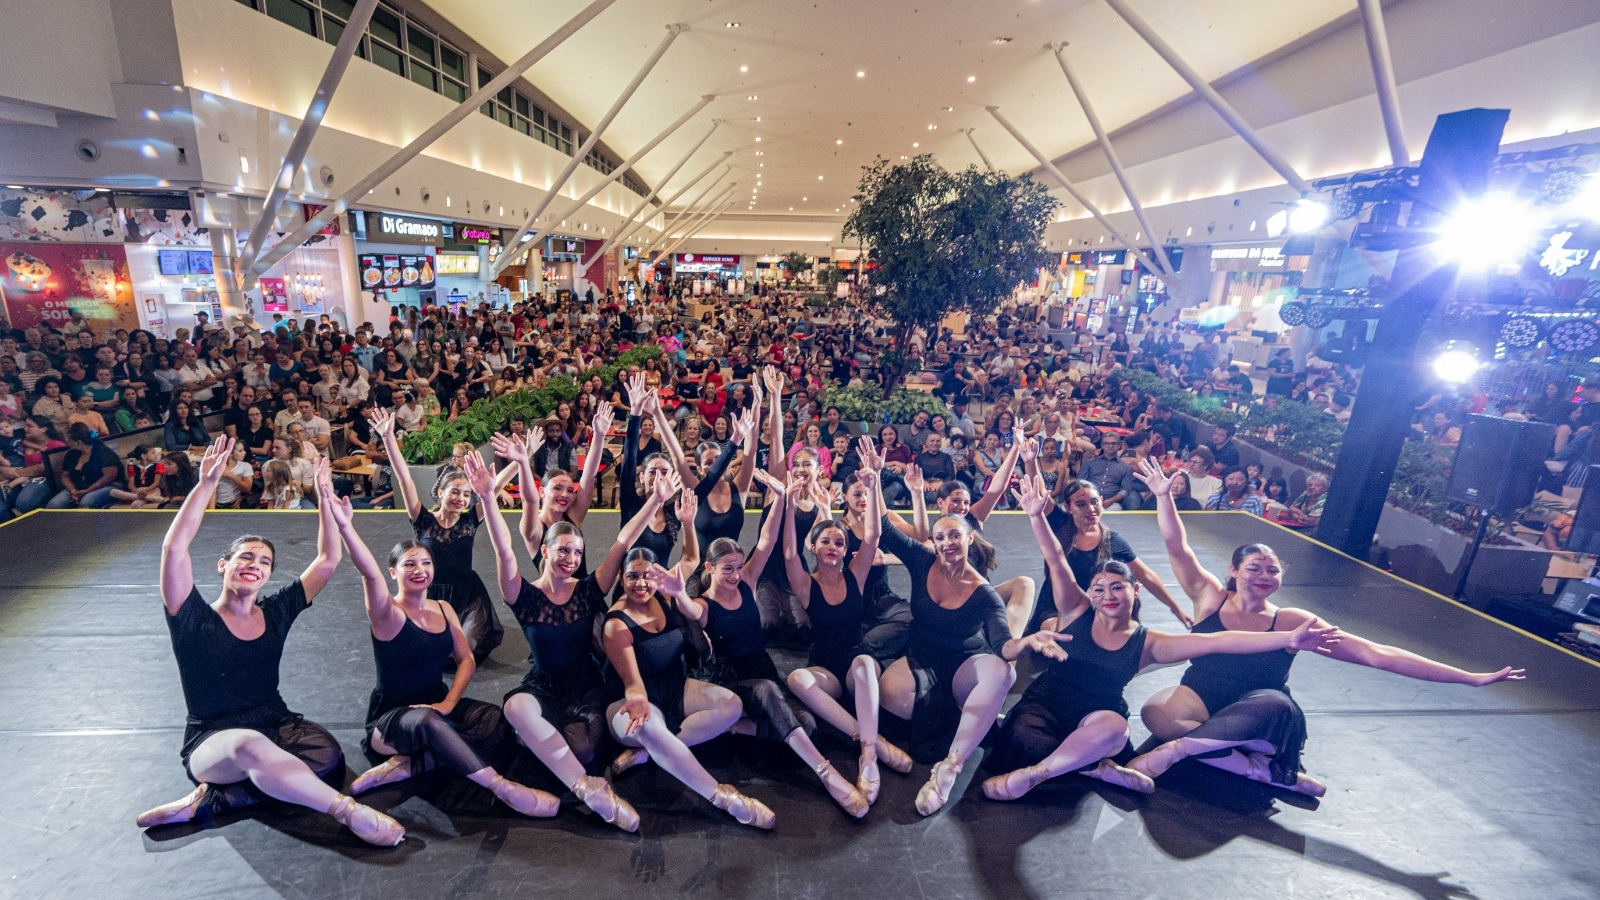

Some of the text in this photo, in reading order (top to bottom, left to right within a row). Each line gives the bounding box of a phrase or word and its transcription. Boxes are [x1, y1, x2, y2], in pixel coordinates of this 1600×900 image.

[382, 216, 395, 234] Di
[56, 300, 100, 308] MELHOR
[41, 310, 110, 320] SORETE
